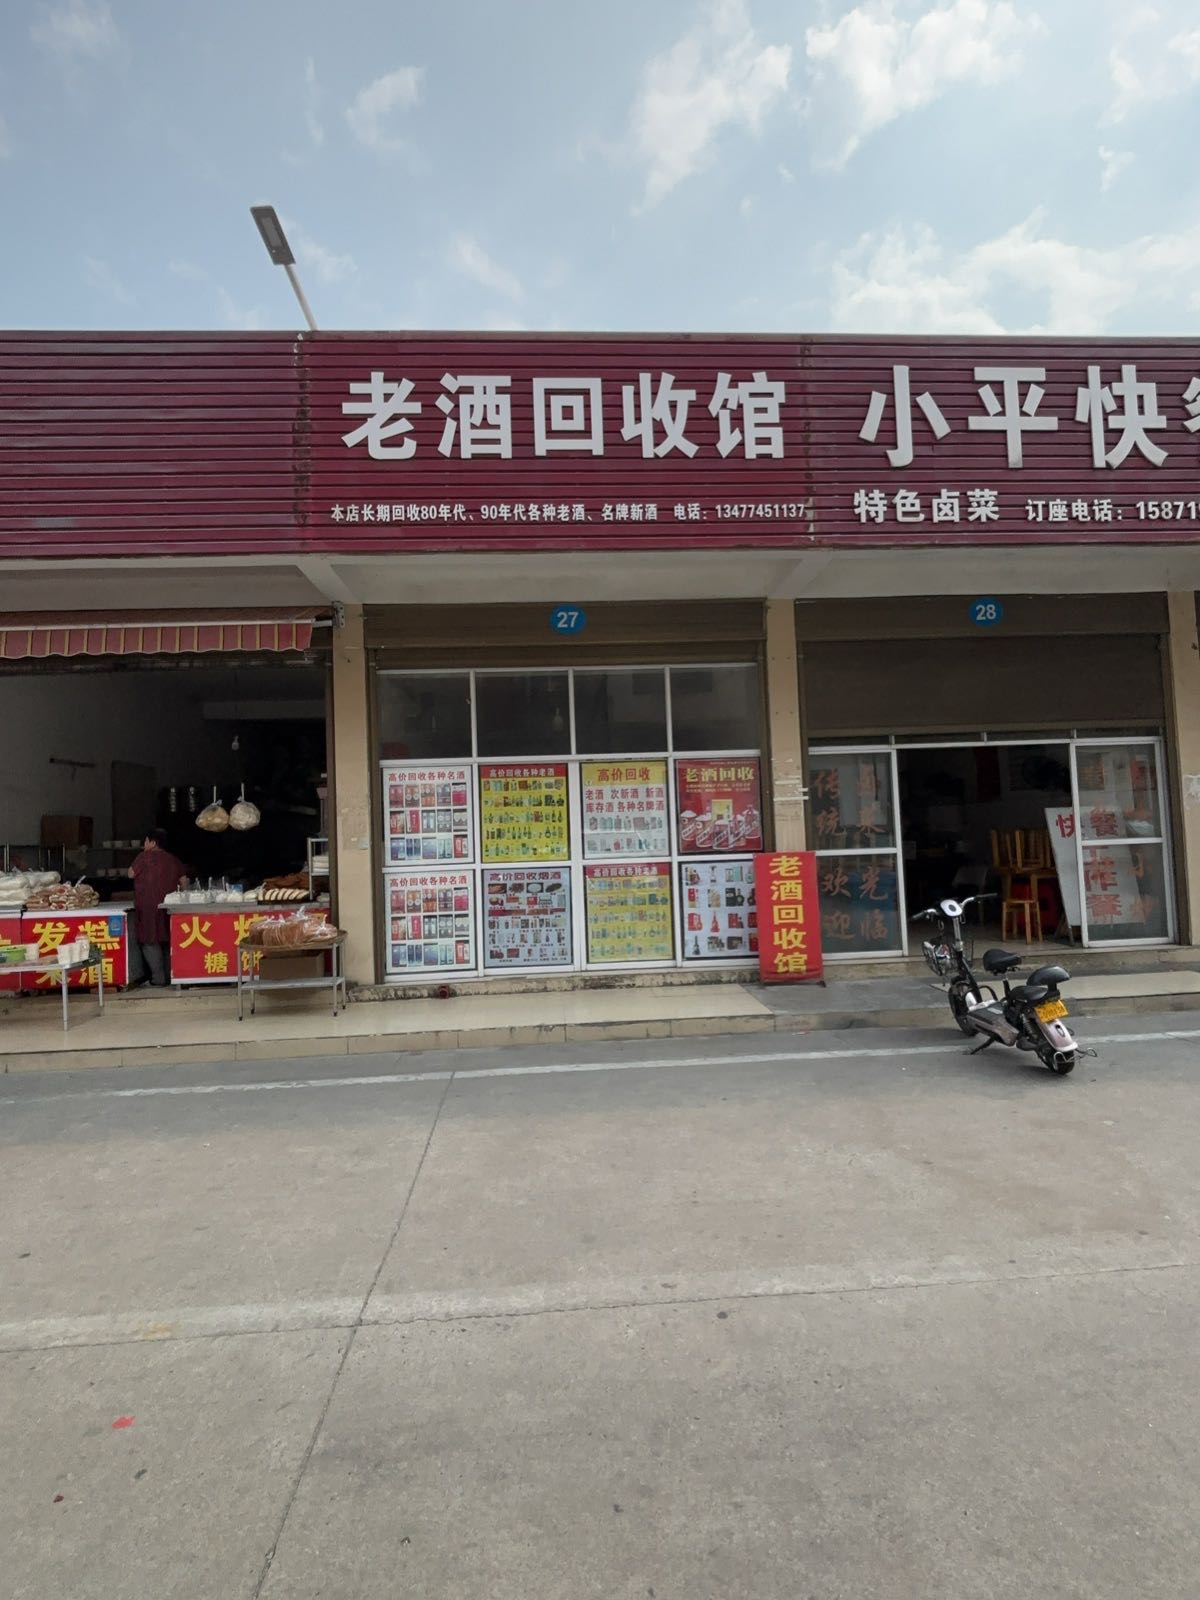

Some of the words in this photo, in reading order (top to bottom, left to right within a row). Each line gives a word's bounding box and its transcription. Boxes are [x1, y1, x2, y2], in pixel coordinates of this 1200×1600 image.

[341, 371, 786, 460] 老酒回收馆
[858, 364, 1200, 469] 小平快
[854, 488, 1000, 523] 特色卤菜
[1025, 498, 1200, 522] 订座电话：15871
[557, 611, 580, 629] 27
[975, 603, 997, 621] 28
[388, 771, 466, 782] 高价回收各种名酒
[597, 767, 651, 782] 高价回收
[685, 766, 755, 783] 老酒回收
[585, 788, 605, 801] 老酒
[389, 875, 468, 887] 高价回收各种名酒
[489, 871, 562, 882] 高价回收烟酒
[769, 855, 809, 973] 老酒回收馆
